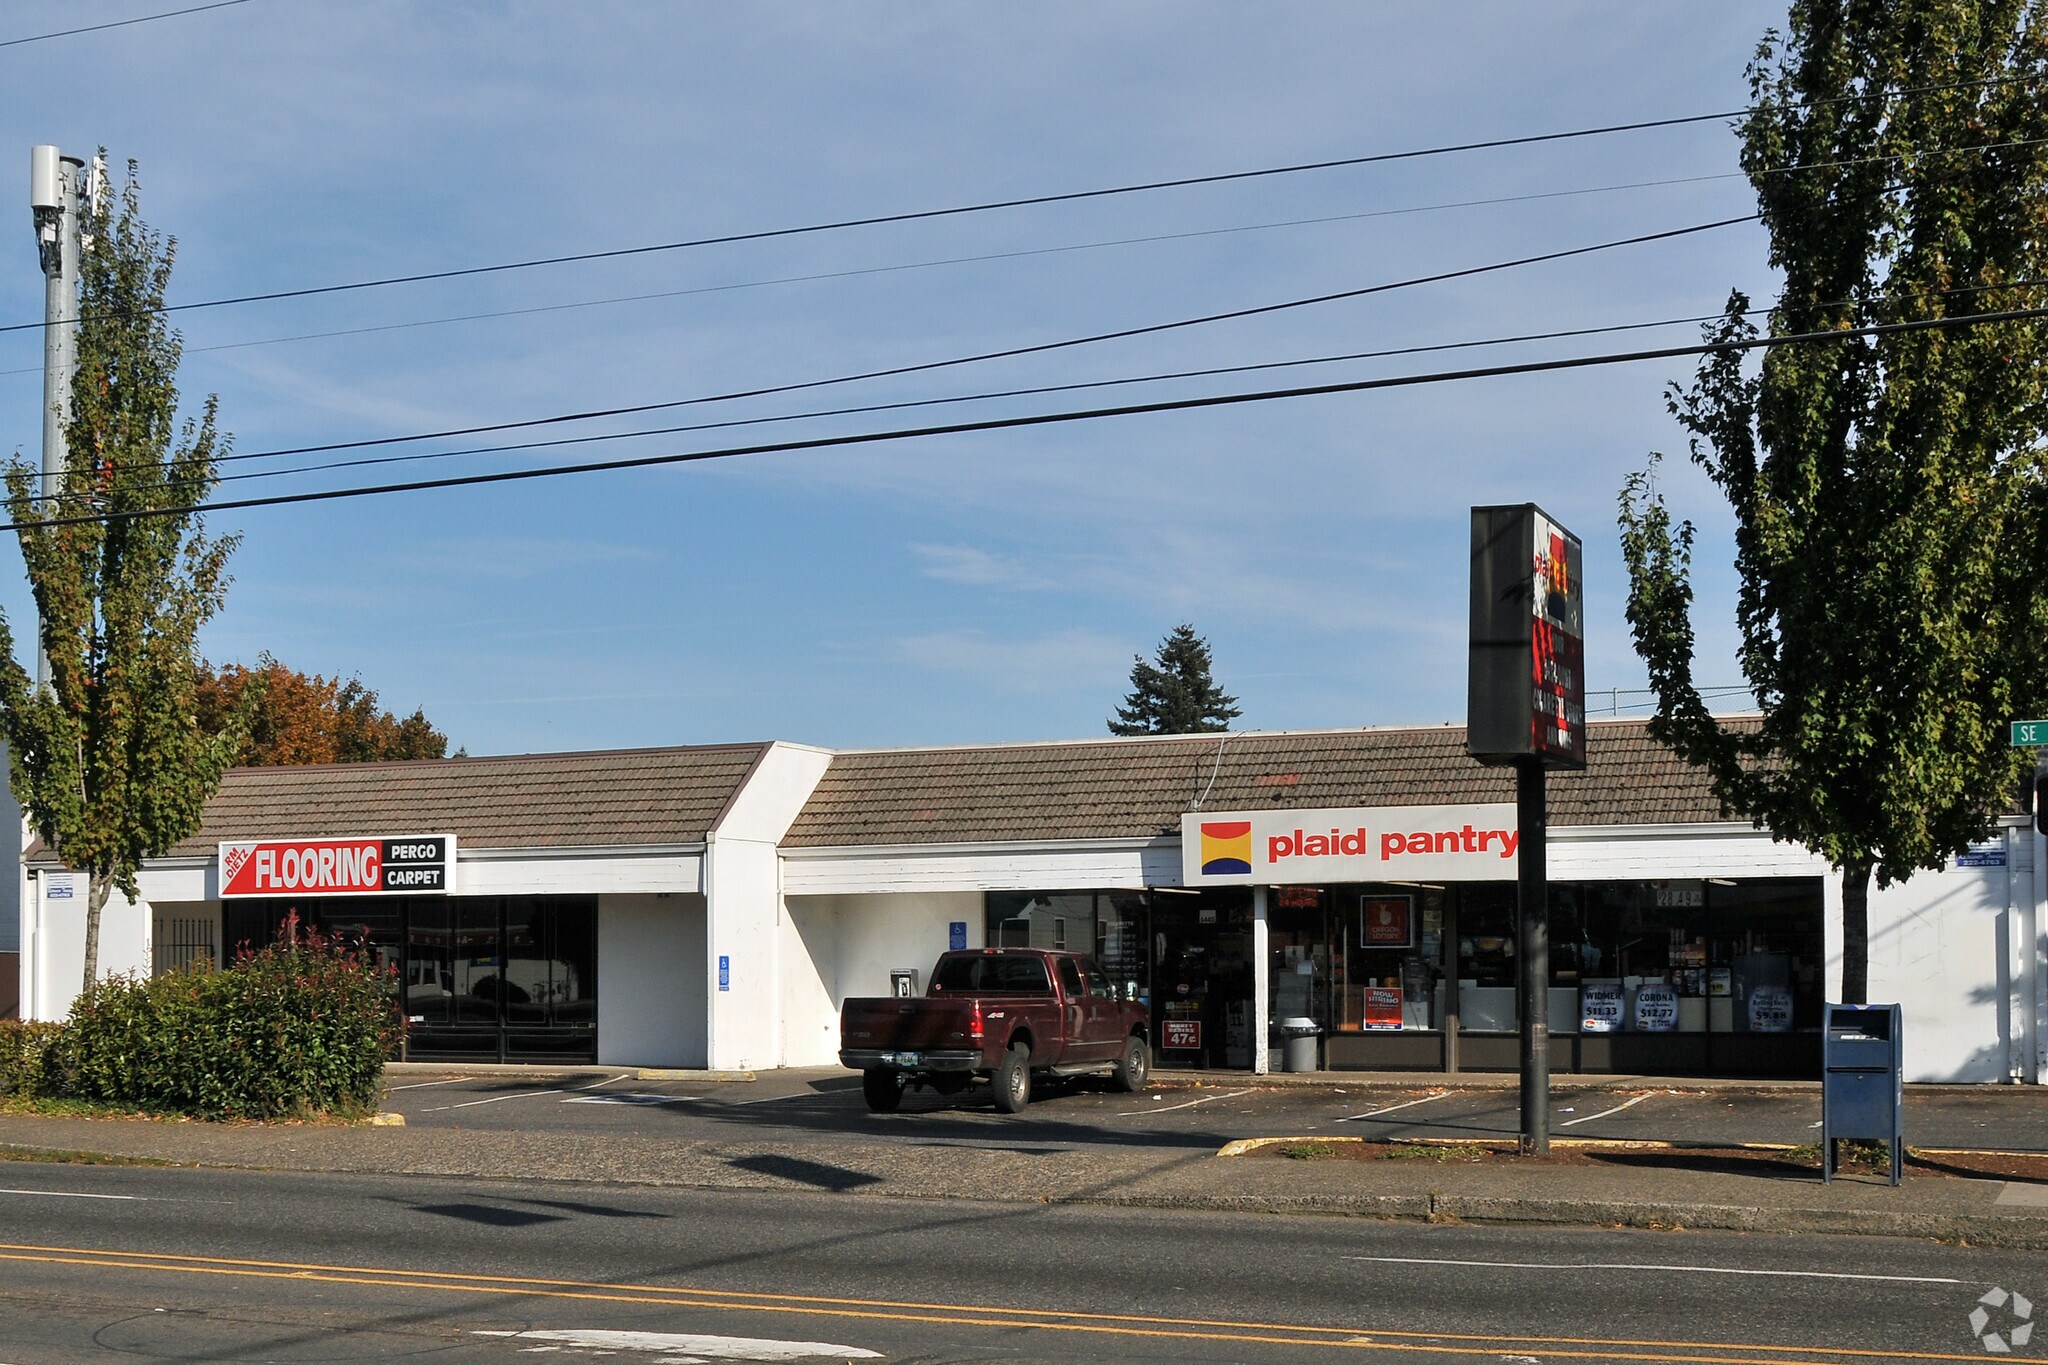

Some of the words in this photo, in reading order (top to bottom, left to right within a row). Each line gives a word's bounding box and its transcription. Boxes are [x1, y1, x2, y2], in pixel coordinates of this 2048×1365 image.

[2021, 725, 2037, 741] SE
[1268, 827, 1367, 863] plaid
[1381, 824, 1517, 861] pantry
[224, 847, 240, 866] RM
[391, 844, 437, 860] PERGO
[225, 849, 249, 879] DIETZ
[255, 846, 379, 889] FLOORING
[387, 870, 440, 885] CARPET
[1368, 996, 1399, 1004] HIRING
[1373, 990, 1394, 998] NOW
[1586, 992, 1621, 1000] WIDMER
[1640, 993, 1674, 1002] CORONA
[1586, 1007, 1618, 1016] $11.33
[1640, 1009, 1674, 1018] $12.77
[1171, 1033, 1197, 1044] 47¢
